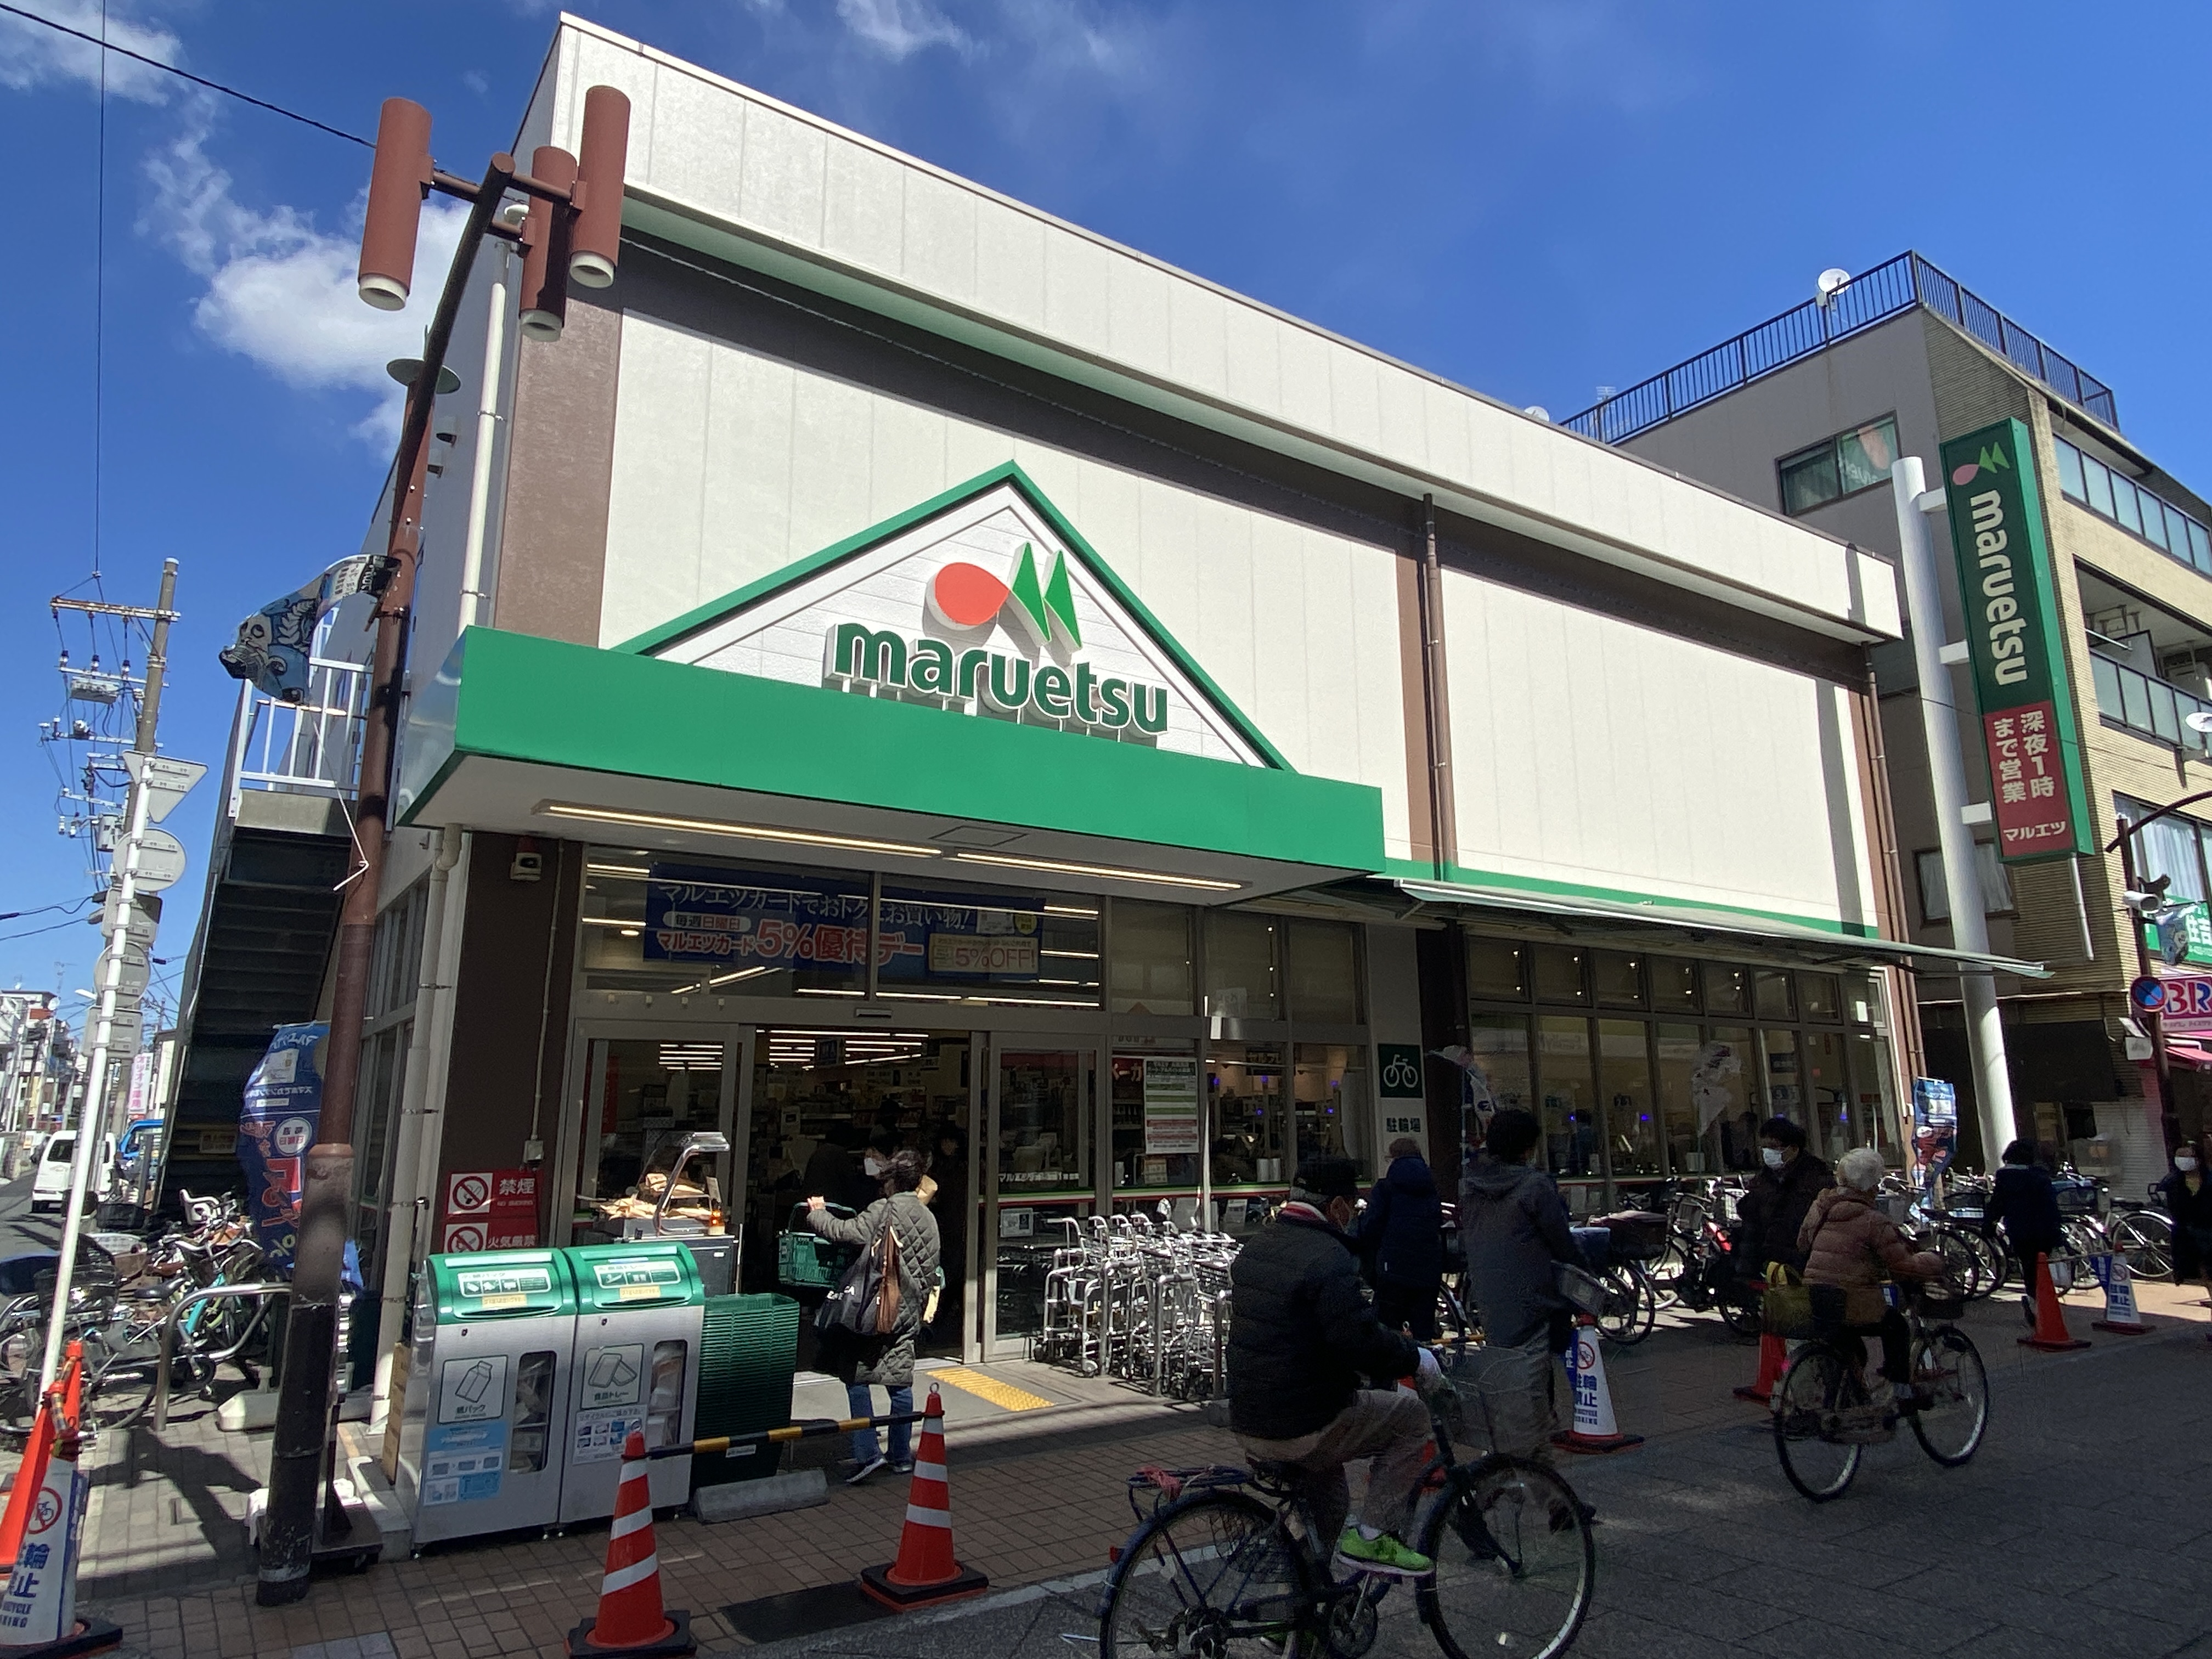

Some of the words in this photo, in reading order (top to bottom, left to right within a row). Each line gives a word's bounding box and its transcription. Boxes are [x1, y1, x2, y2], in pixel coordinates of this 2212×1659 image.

[1970, 490, 2028, 686] maruetsu
[827, 622, 1169, 736] maruetsu
[1993, 718, 2027, 803] まで営業
[2021, 710, 2055, 798] 深夜1時
[2003, 821, 2066, 841] マルエツ
[675, 914, 740, 931] 毎週日曜日
[1386, 1118, 1421, 1133] 駐輪場
[499, 1178, 535, 1195] 禁煙
[487, 1234, 536, 1249] 火気厳禁
